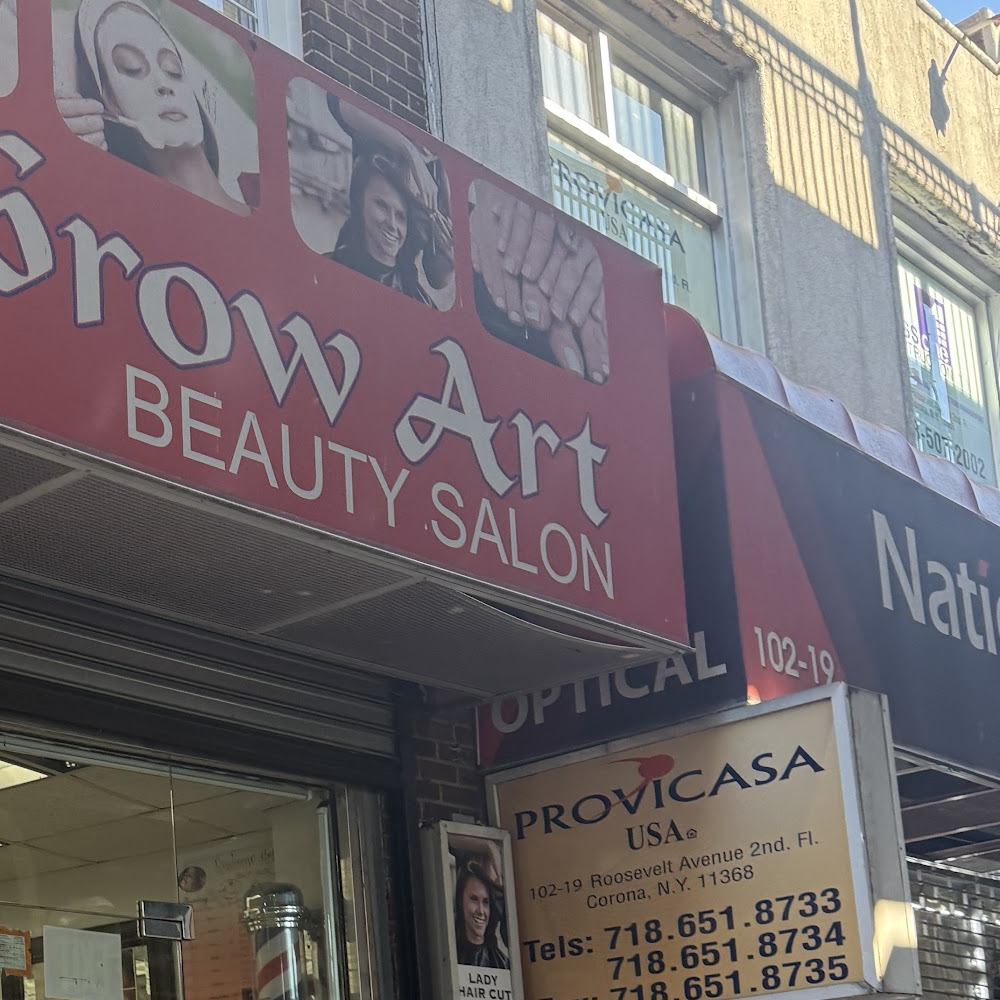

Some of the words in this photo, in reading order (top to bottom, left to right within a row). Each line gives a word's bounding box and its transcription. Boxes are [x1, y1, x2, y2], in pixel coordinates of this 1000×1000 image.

[550, 155, 687, 255] ROVICASA
[394, 336, 609, 528] Art
[125, 363, 411, 528] BEAUTY
[430, 481, 616, 600] SALON
[872, 508, 1000, 656] Nati
[491, 632, 728, 734] OPTICAL
[754, 625, 836, 686] 102-19
[514, 745, 825, 841] PROVICASA
[529, 878, 583, 901] 102-19
[590, 860, 674, 890] Roosevelt
[679, 846, 745, 872] Avenue
[750, 835, 791, 858] 2nd.
[797, 830, 820, 848] Fl.
[626, 819, 684, 851] USA
[586, 888, 652, 911] Corona,
[657, 878, 692, 899] N.Y.
[698, 864, 755, 889] 11368
[523, 935, 594, 964] Tels:
[604, 887, 842, 951] 718.651.8733
[606, 920, 847, 981] 718.651.8734
[459, 986, 486, 1000] HAIR
[468, 973, 498, 986] LADY
